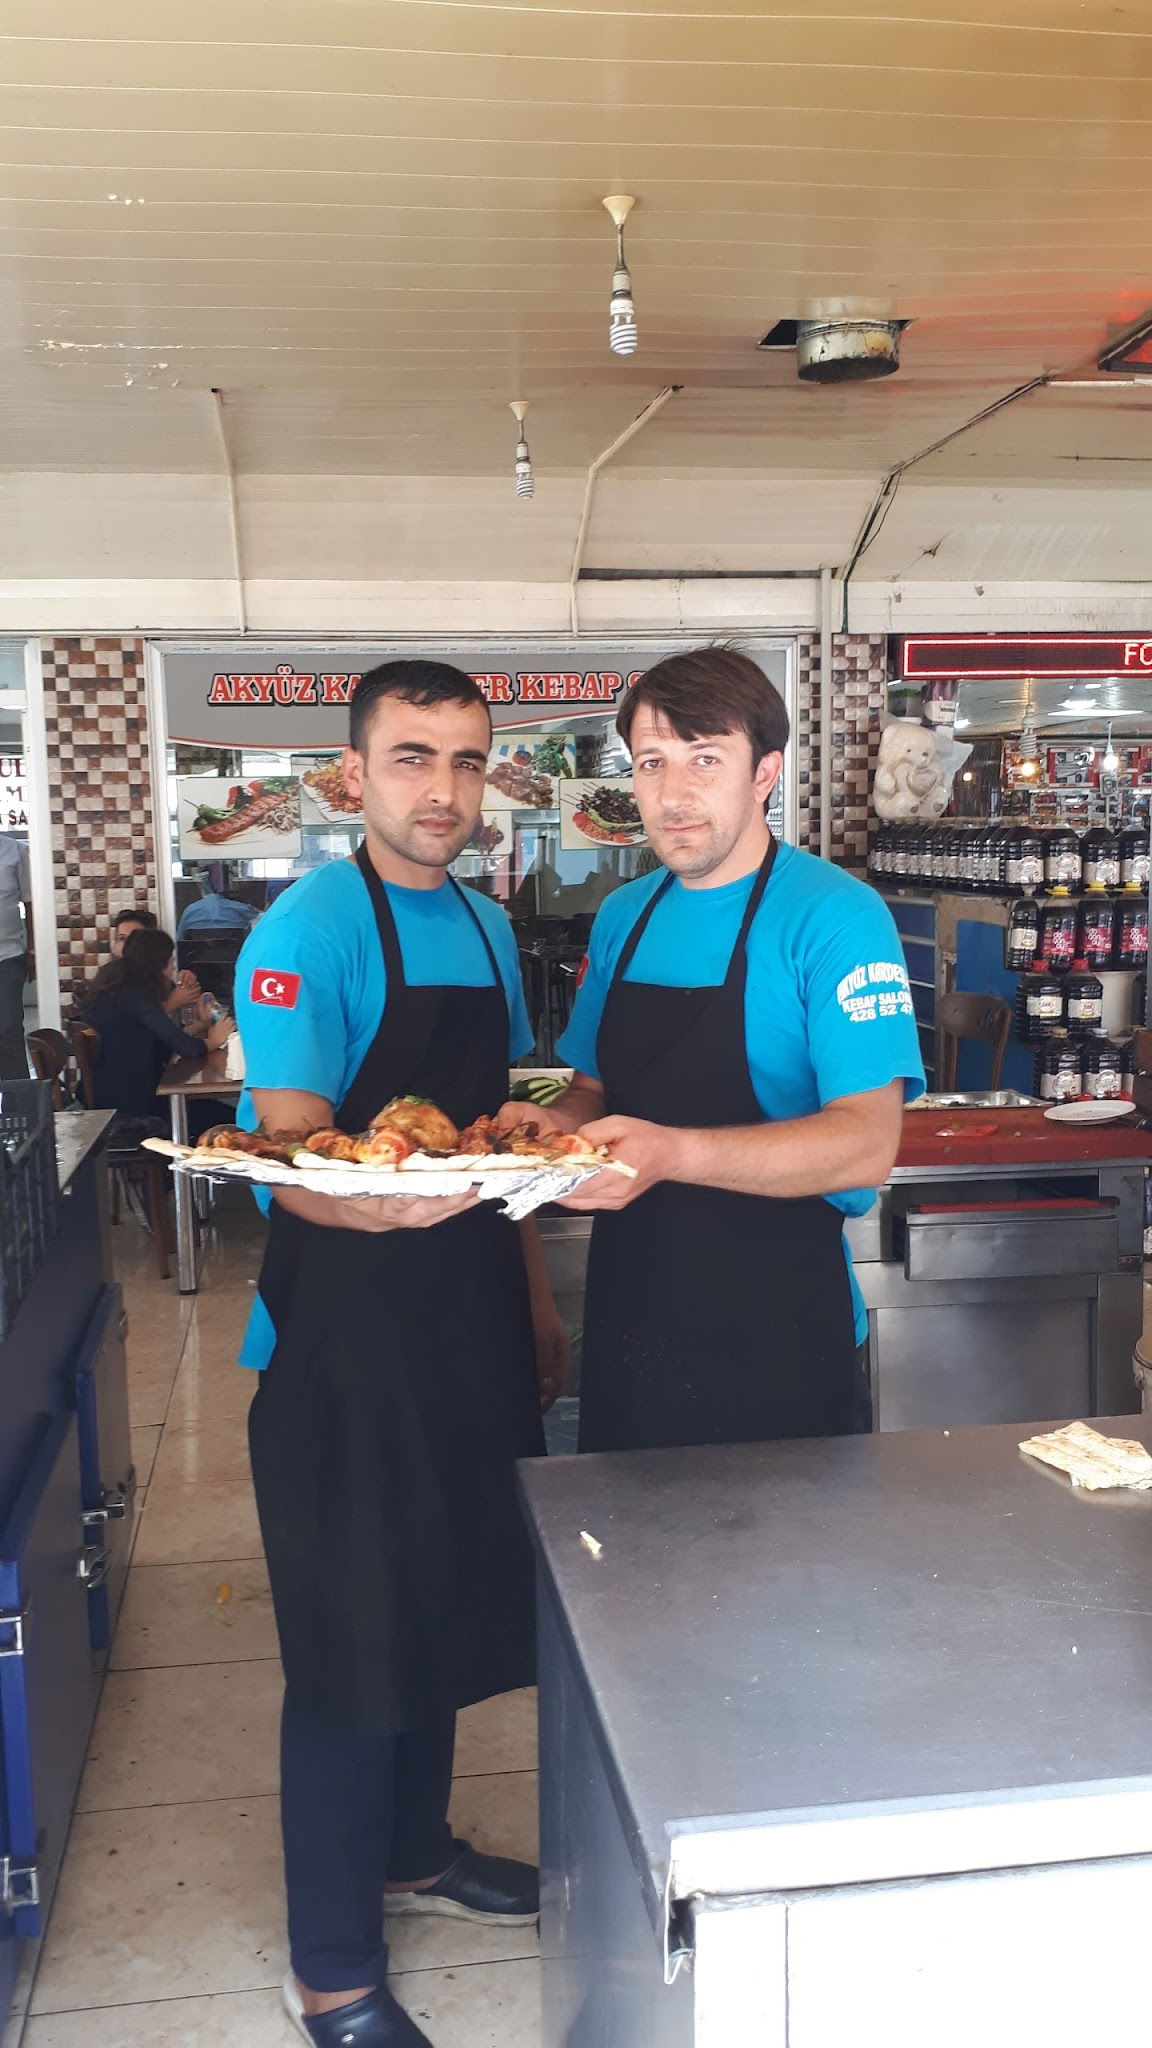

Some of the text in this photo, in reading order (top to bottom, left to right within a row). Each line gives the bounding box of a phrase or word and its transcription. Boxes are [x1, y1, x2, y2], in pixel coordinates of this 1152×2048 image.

[208, 664, 318, 705] AKYÜZ
[517, 672, 622, 704] KEBAP
[841, 994, 877, 1014] KEBAP
[849, 1008, 877, 1023] 428
[878, 1004, 898, 1017] 52
